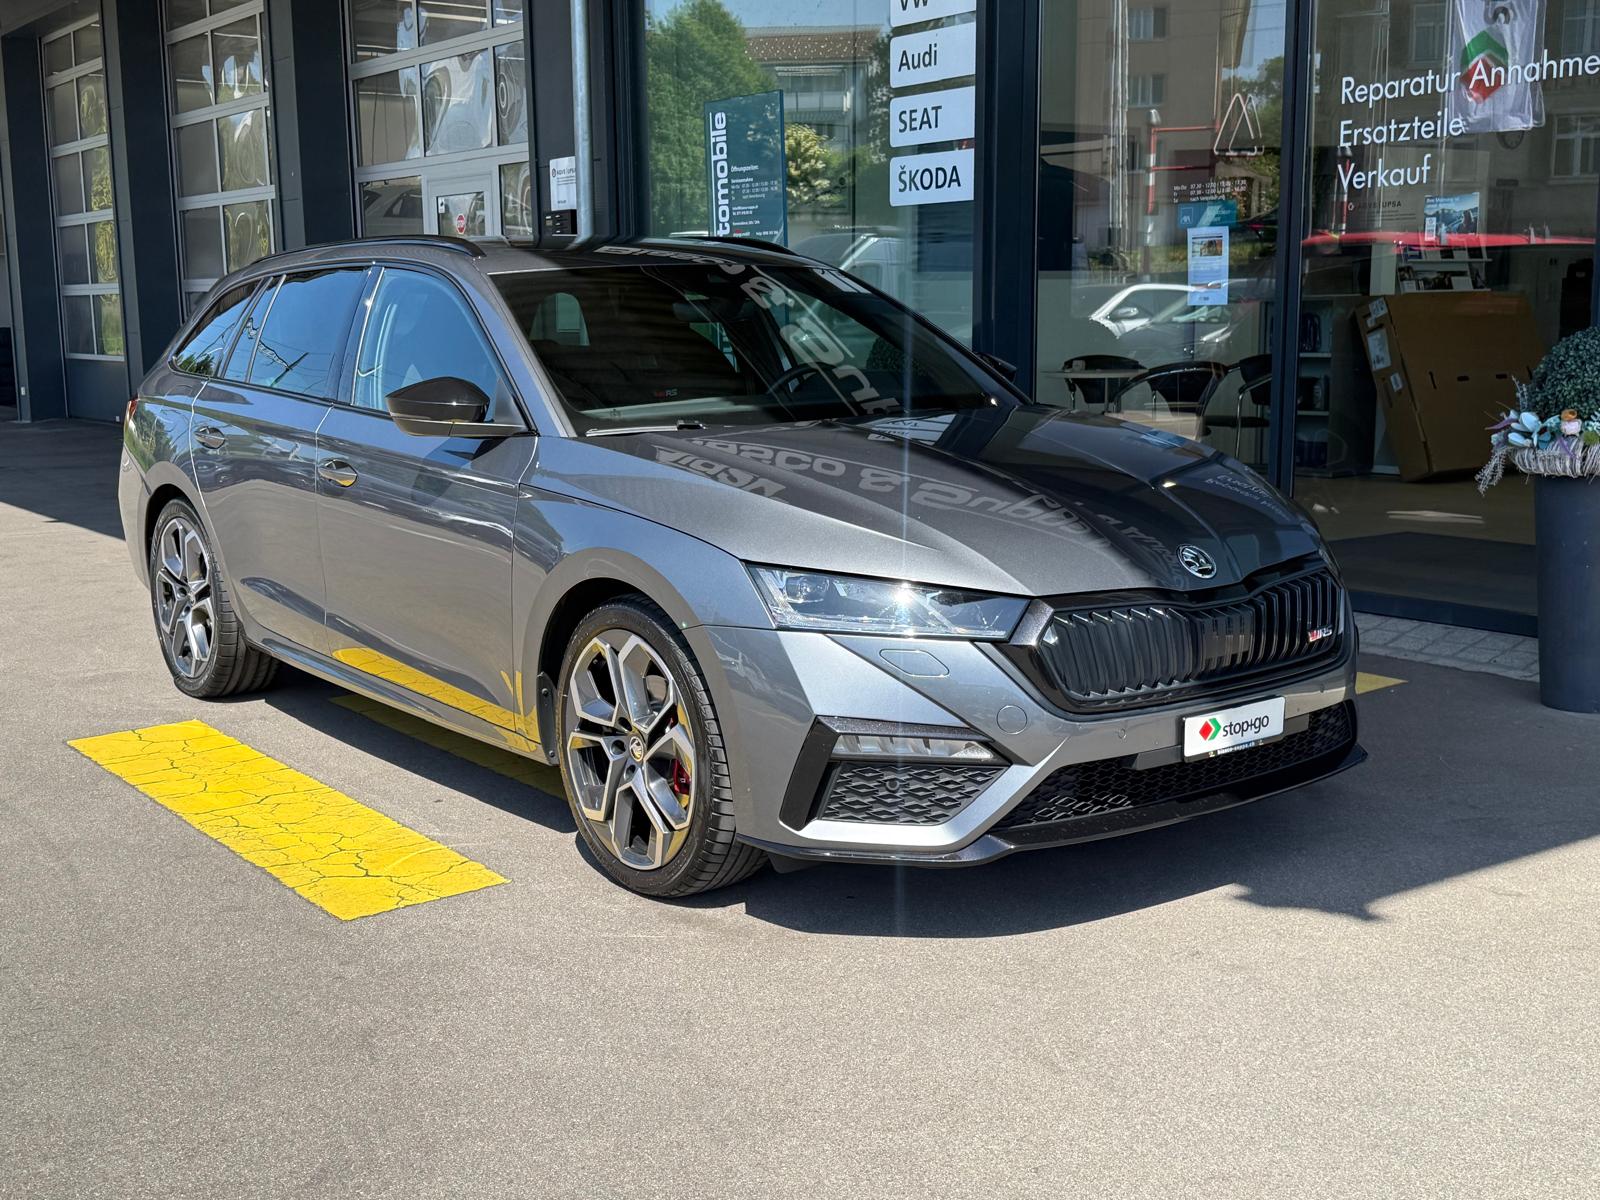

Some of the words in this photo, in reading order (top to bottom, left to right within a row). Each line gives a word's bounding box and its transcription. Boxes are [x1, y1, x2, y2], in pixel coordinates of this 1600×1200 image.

[898, 43, 938, 72] Audi
[1341, 69, 1461, 108] Reparatur
[1469, 49, 1600, 90] Annahme
[898, 105, 942, 133] SEAT
[1338, 108, 1466, 148] Ersatzteile
[898, 164, 961, 193] ŠKODA
[1337, 153, 1431, 190] Verkauf
[1222, 714, 1270, 737] stop+go
